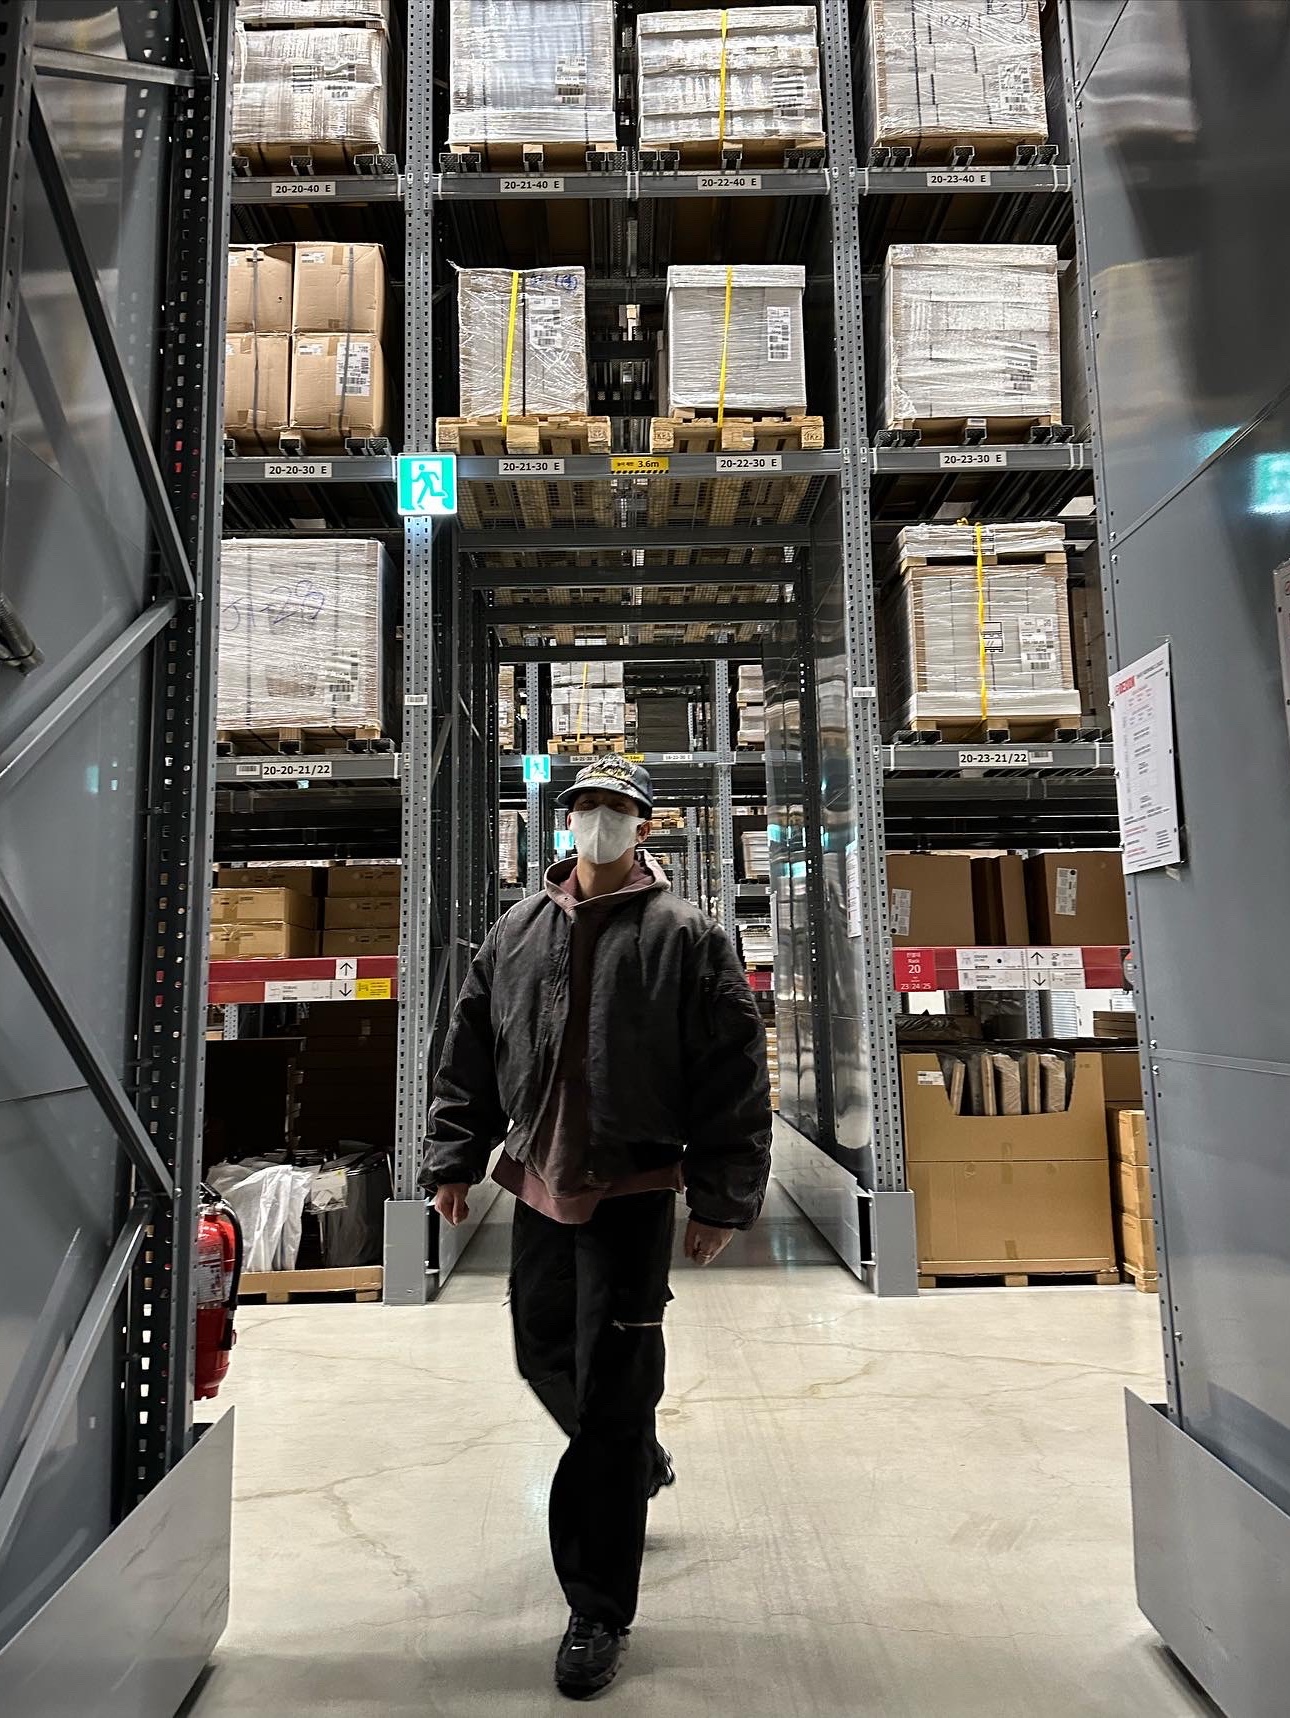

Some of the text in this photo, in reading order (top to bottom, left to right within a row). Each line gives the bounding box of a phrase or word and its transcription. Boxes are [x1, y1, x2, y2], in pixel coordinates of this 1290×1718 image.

[702, 178, 757, 187] 20-22-40 E
[931, 175, 986, 184] 20-23-40 E
[275, 184, 331, 193] 20-20-40 E
[504, 180, 560, 189] 20-21-40 E
[720, 458, 777, 468] 20-22-30 E
[944, 454, 1002, 464] 20-23-30 E
[503, 462, 560, 471] 20-21-30 E
[637, 460, 660, 468] 3.6m
[269, 466, 327, 475] 20-20-30 E
[960, 753, 1027, 764] 20-23-21/22
[263, 764, 330, 776] 20-20-21/22
[908, 964, 921, 974] 20
[922, 982, 931, 990] 25
